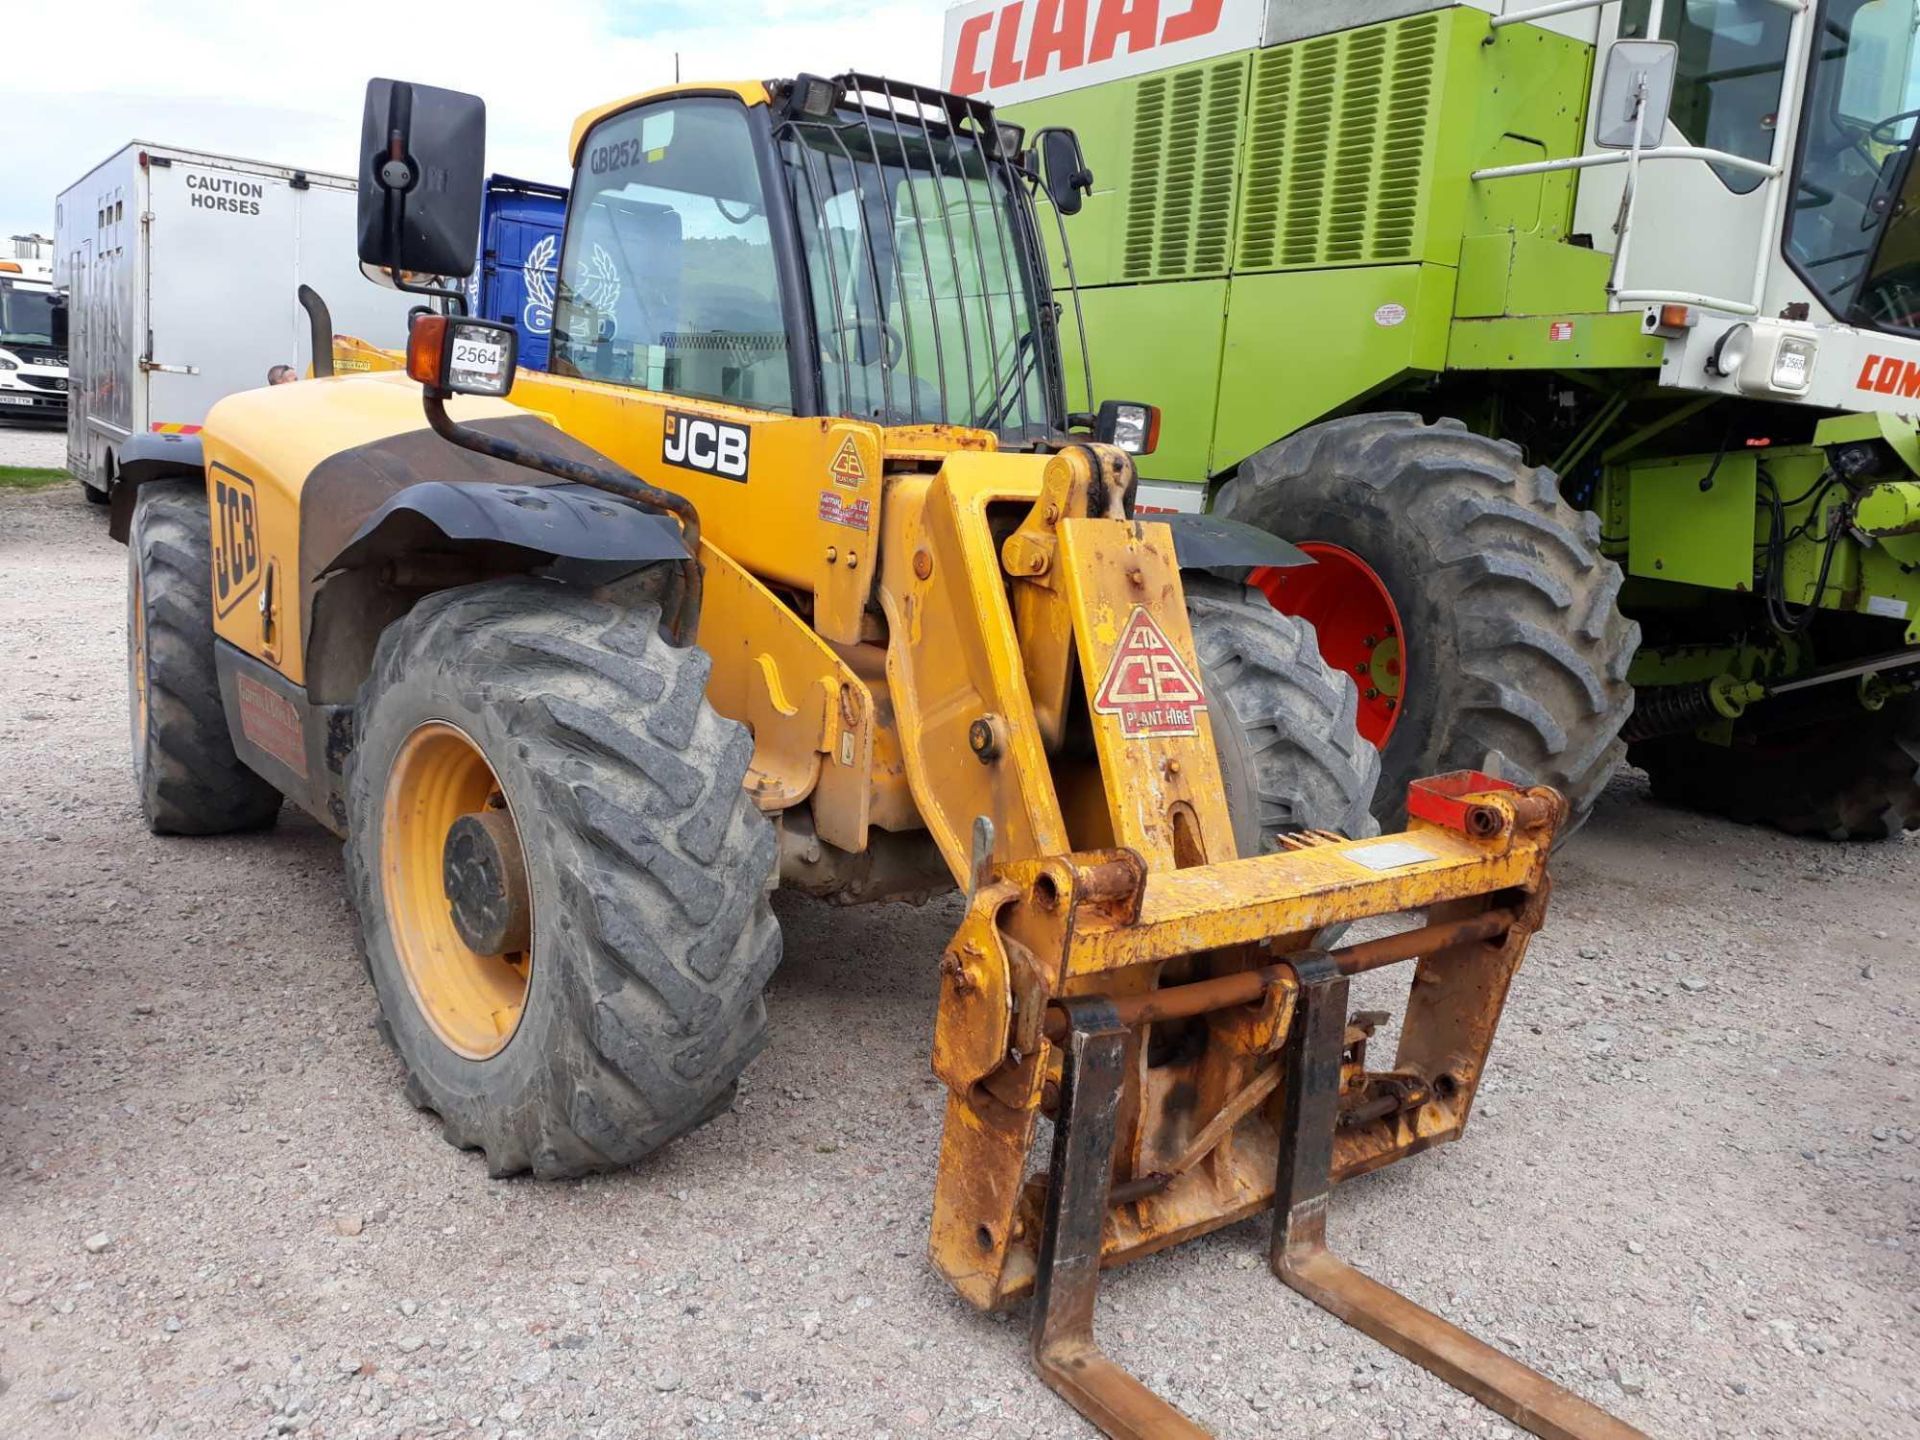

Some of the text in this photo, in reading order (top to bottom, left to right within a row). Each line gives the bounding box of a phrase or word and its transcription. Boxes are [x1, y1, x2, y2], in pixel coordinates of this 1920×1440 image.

[591, 138, 641, 175] GB1252
[186, 174, 262, 199] CAUTION
[191, 193, 260, 215] HORSES
[456, 345, 498, 365] 2564
[664, 418, 747, 476] JCB
[215, 480, 257, 600] JCB
[1108, 655, 1199, 702] GB
[1126, 707, 1190, 727] PLANT HIRE
